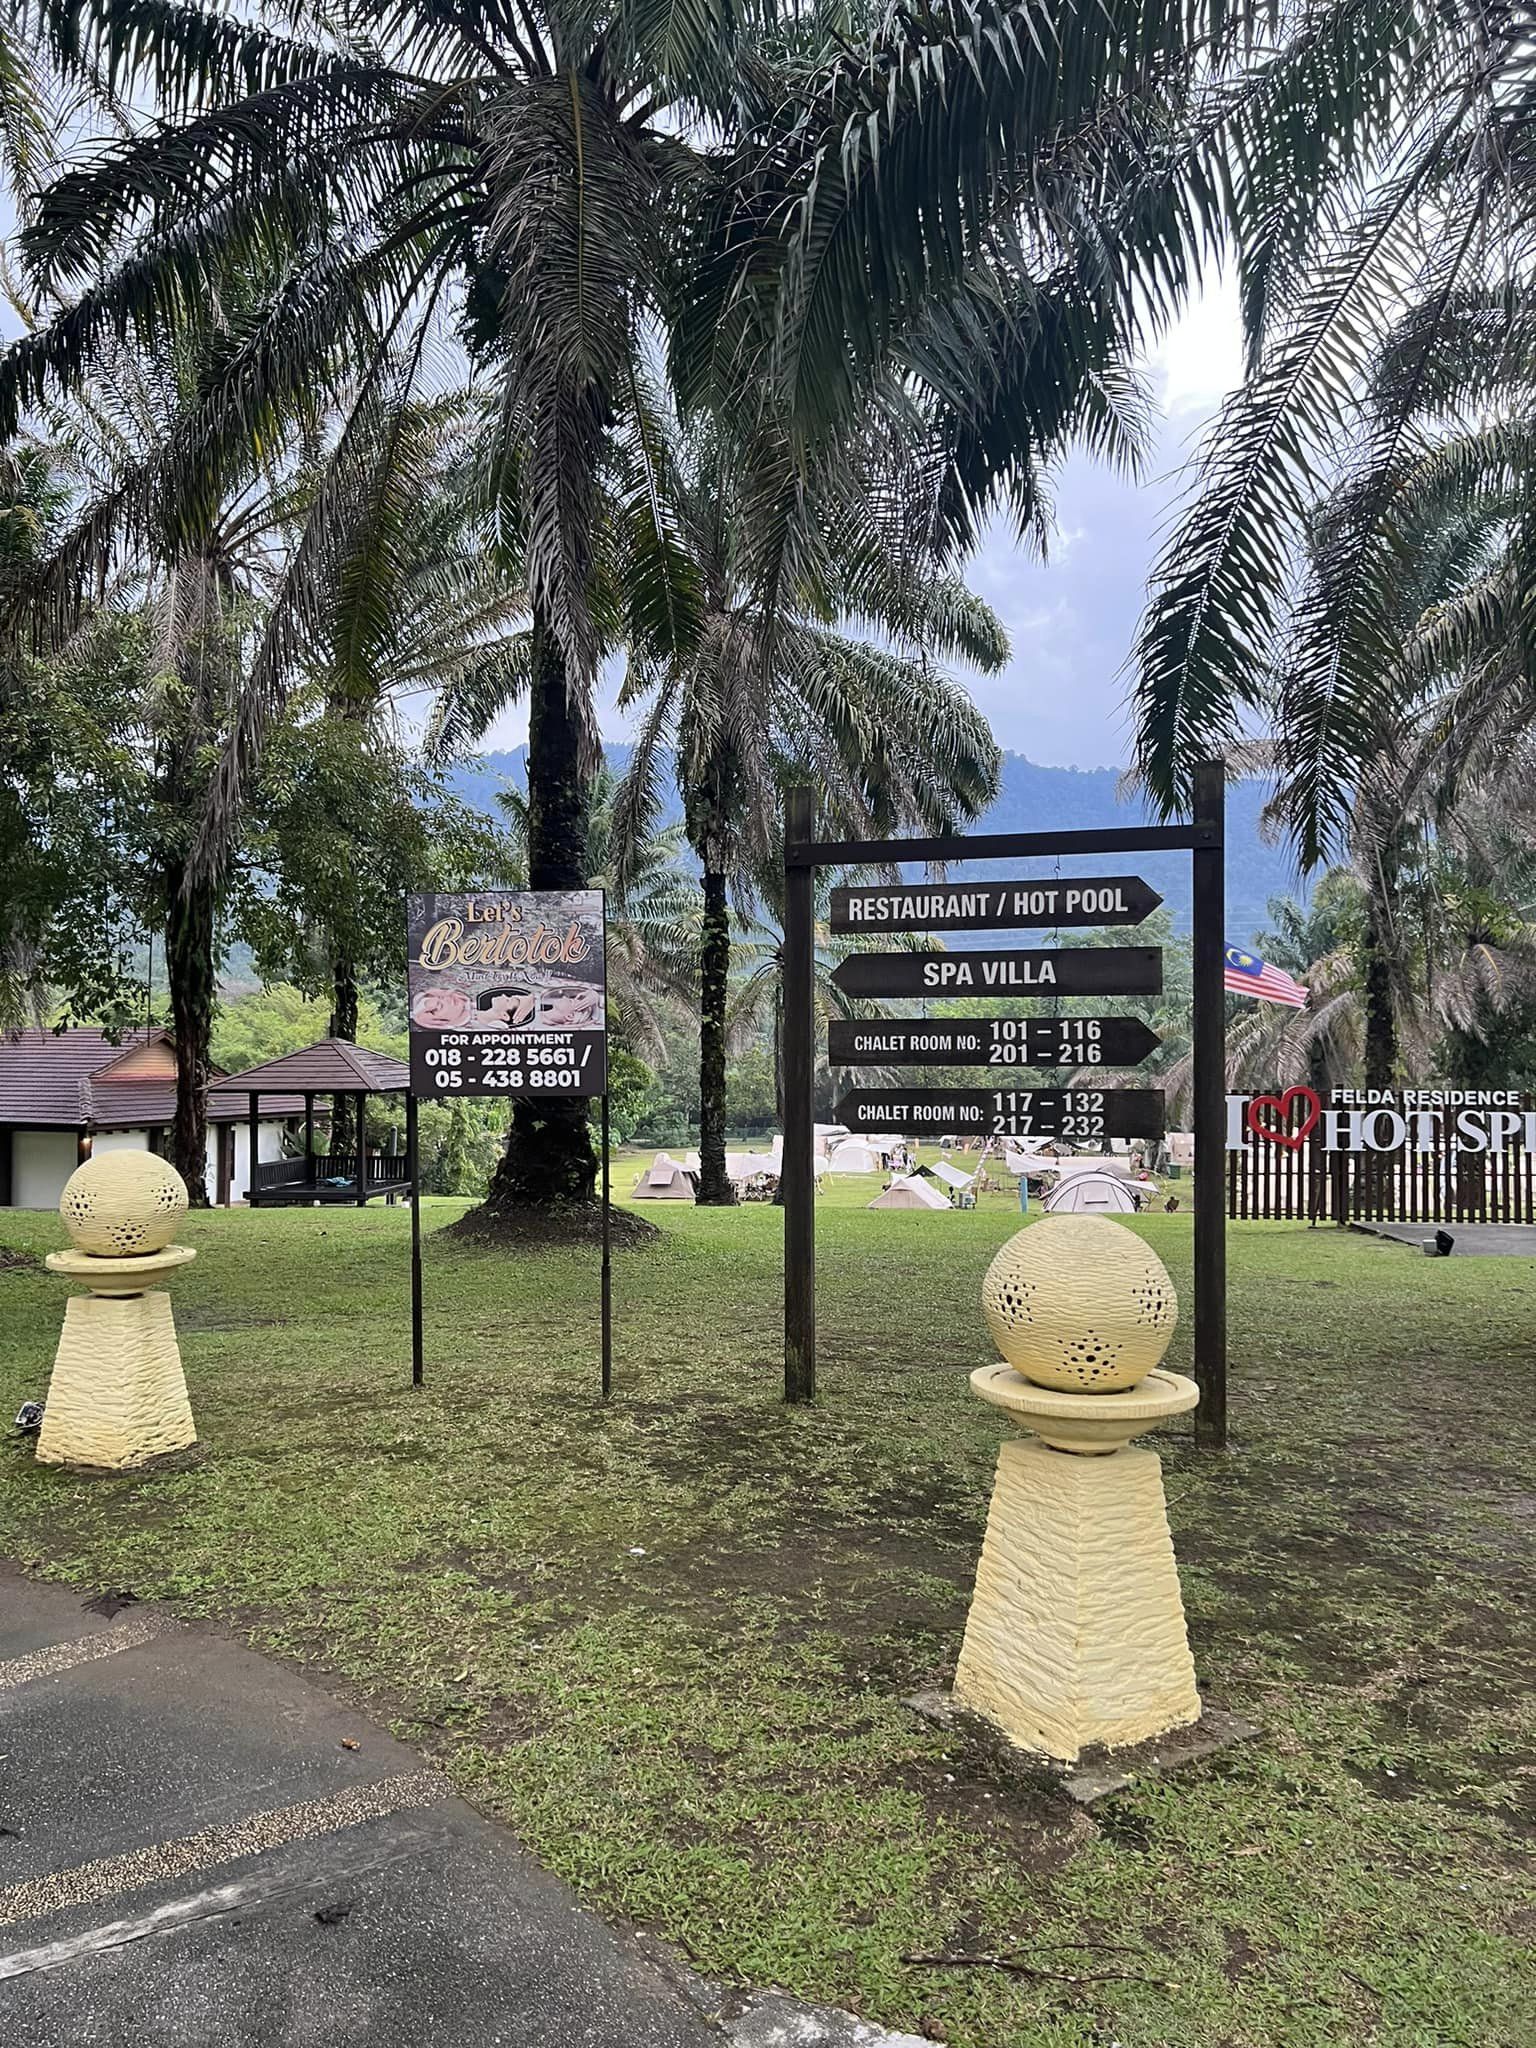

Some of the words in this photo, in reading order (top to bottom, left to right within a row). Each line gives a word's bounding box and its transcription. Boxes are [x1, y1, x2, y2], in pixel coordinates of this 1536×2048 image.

[467, 901, 523, 923] Let's
[849, 893, 990, 921] RESTAURANT
[996, 892, 1006, 917] /
[1014, 890, 1059, 916] HOT
[1066, 888, 1128, 914] POOL
[419, 916, 591, 971] Bertotok
[923, 961, 974, 987] SPA
[982, 960, 1057, 985] VILLA
[441, 1034, 469, 1045] FOR
[472, 1033, 573, 1045] APPOINTMENT
[989, 1021, 1028, 1041] 101
[1059, 1020, 1102, 1041] 116
[854, 1036, 905, 1051] CHALET
[910, 1035, 951, 1050] ROOM
[956, 1035, 981, 1050] NO:
[989, 1043, 1028, 1063] 201
[1059, 1043, 1102, 1063] 216
[425, 1049, 462, 1066] 018
[481, 1049, 521, 1066] 228
[527, 1048, 575, 1066] 5661
[581, 1045, 592, 1067] /
[435, 1071, 462, 1088] 05
[482, 1070, 523, 1088] 438
[530, 1070, 580, 1087] 8801
[992, 1092, 1033, 1112] 117
[1062, 1093, 1105, 1113] 132
[1331, 1089, 1395, 1105] FELDA
[1403, 1090, 1520, 1106] RESIDENCE
[857, 1105, 909, 1121] CHALET
[913, 1105, 955, 1121] ROOM
[959, 1105, 984, 1121] NO:
[1225, 1095, 1251, 1151] I
[1320, 1109, 1444, 1152] HOT
[992, 1115, 1033, 1136] 217
[1062, 1116, 1105, 1136] 232
